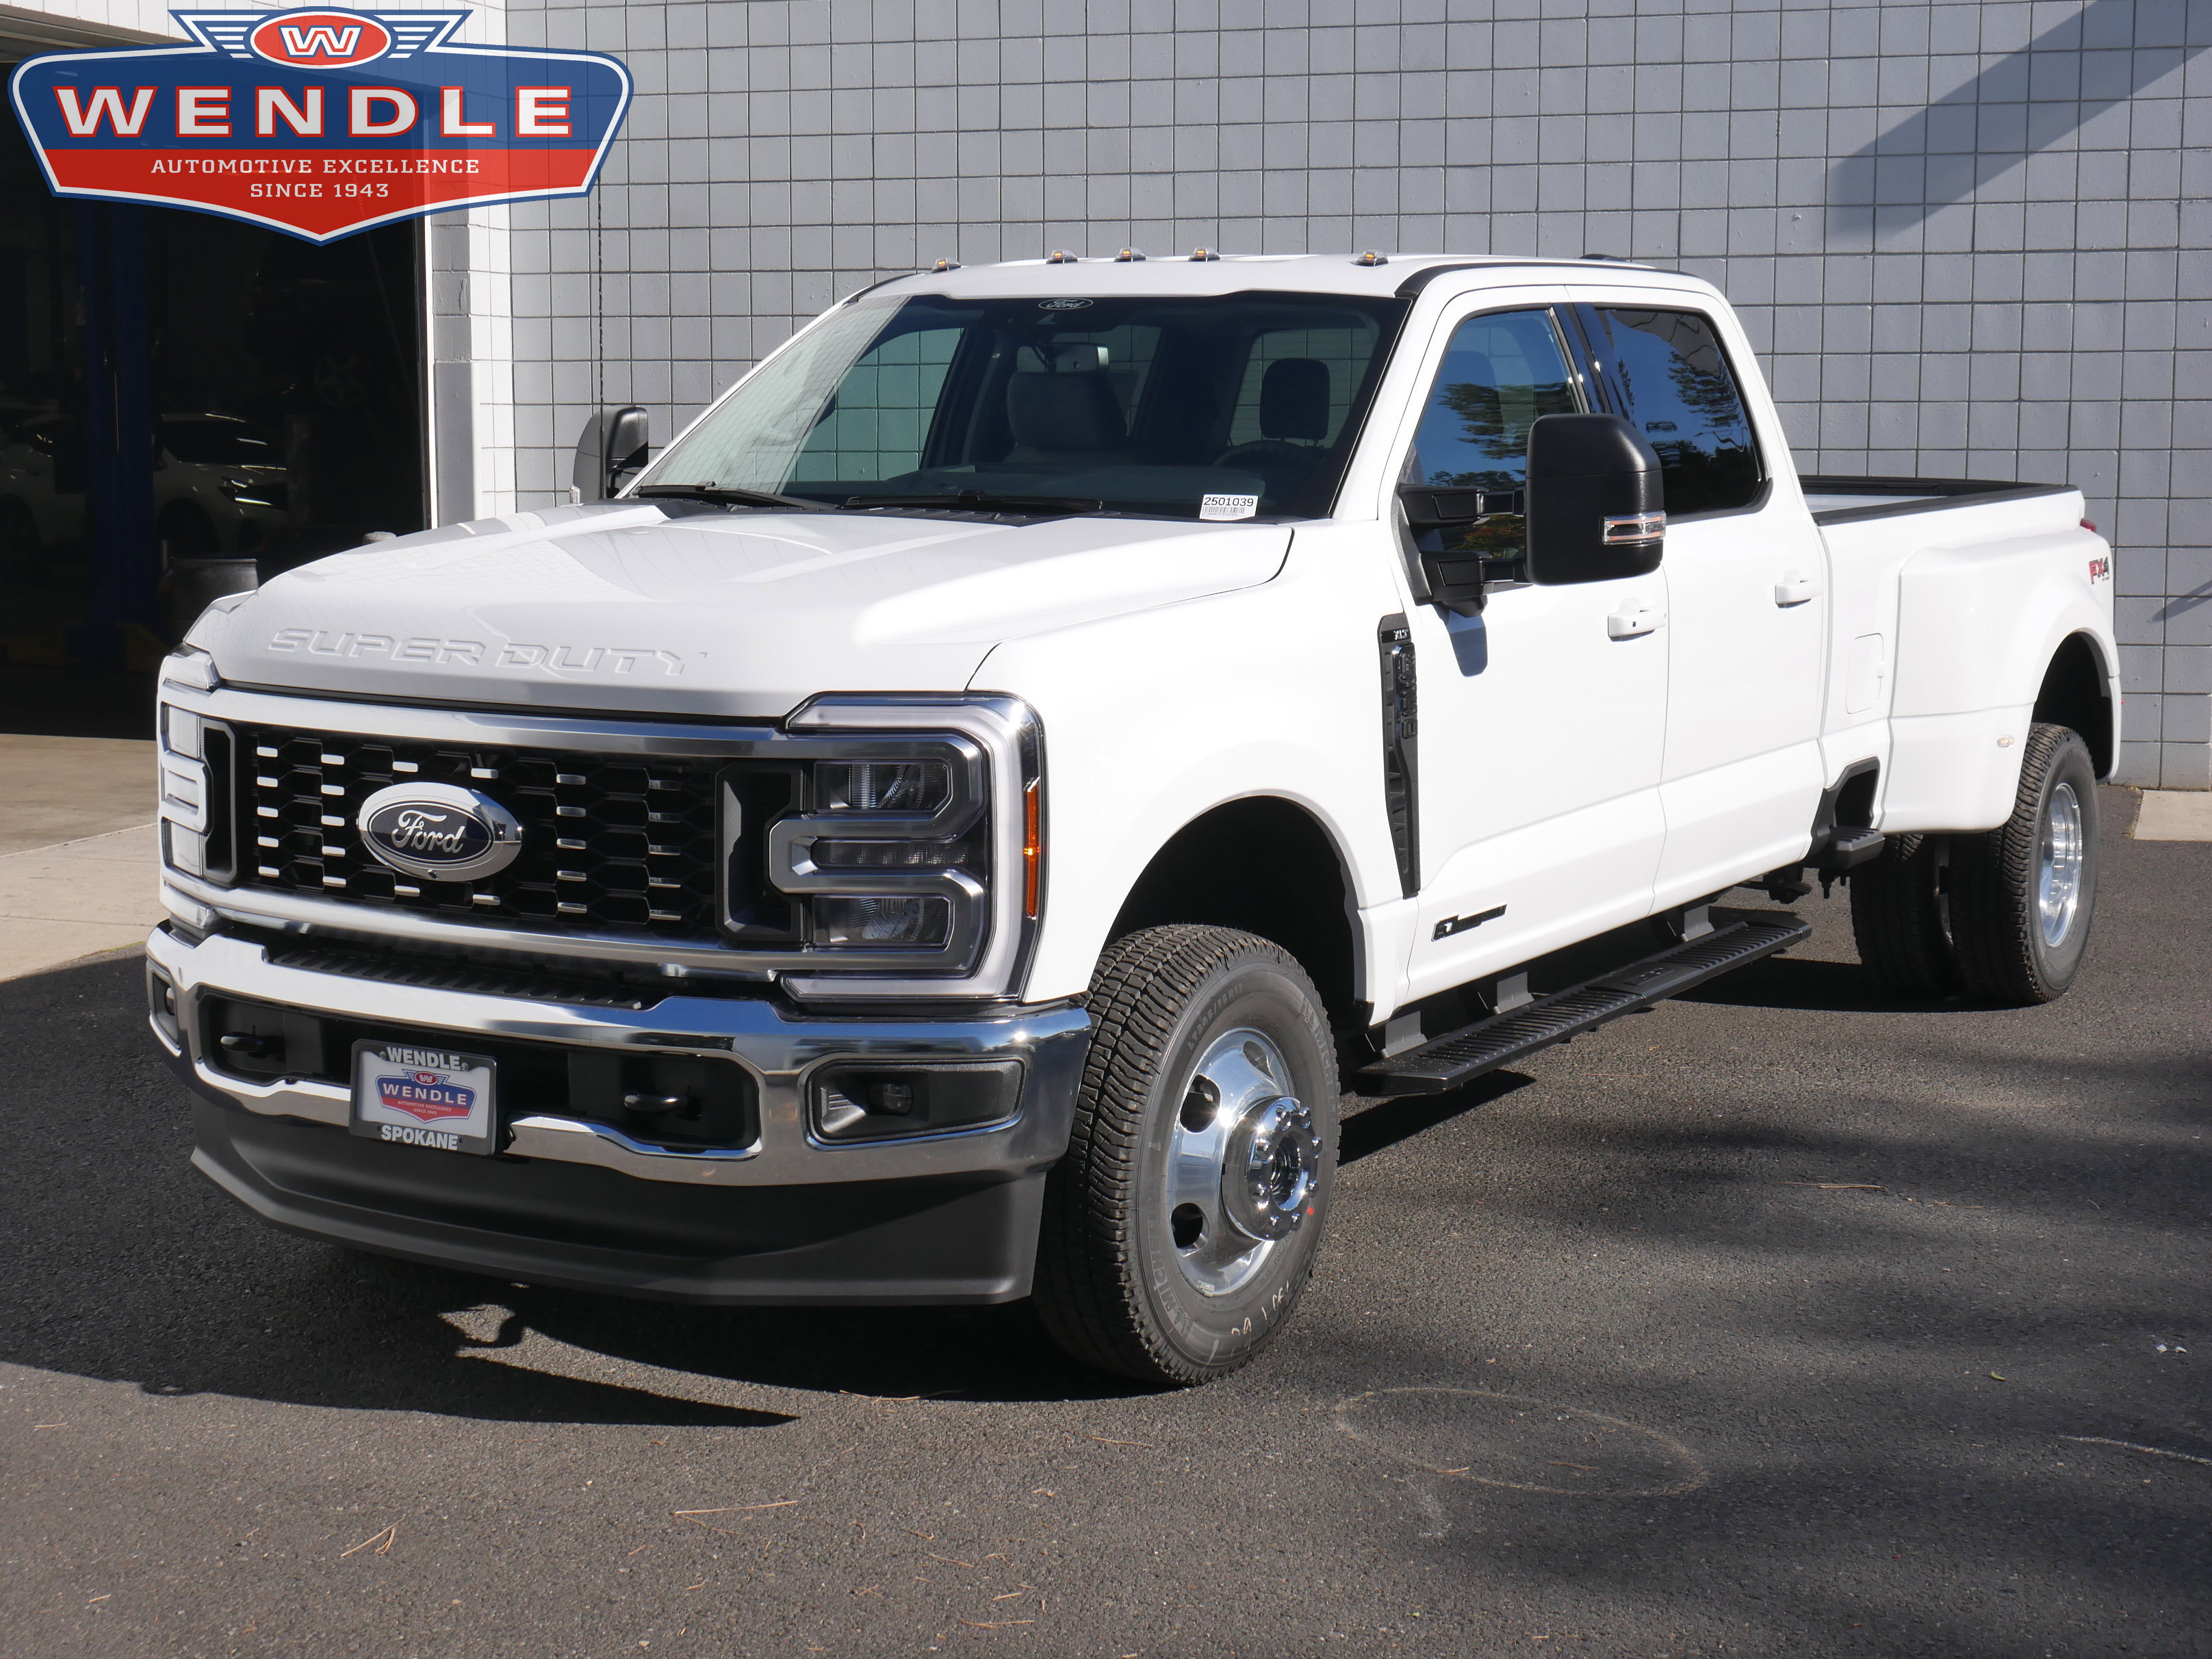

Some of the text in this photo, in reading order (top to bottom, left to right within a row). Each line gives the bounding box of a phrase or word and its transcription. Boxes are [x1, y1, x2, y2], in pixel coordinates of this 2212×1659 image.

[1046, 299, 1085, 308] Ford
[1204, 497, 1254, 507] 2501039
[2089, 556, 2110, 585] FX4
[1393, 628, 1409, 640] XLT
[268, 628, 708, 676] SUPER DUTY
[391, 810, 465, 853] Ford
[387, 1046, 461, 1071] WENDLE
[383, 1083, 467, 1105] WENDLE
[381, 1124, 459, 1150] SPOKANE
